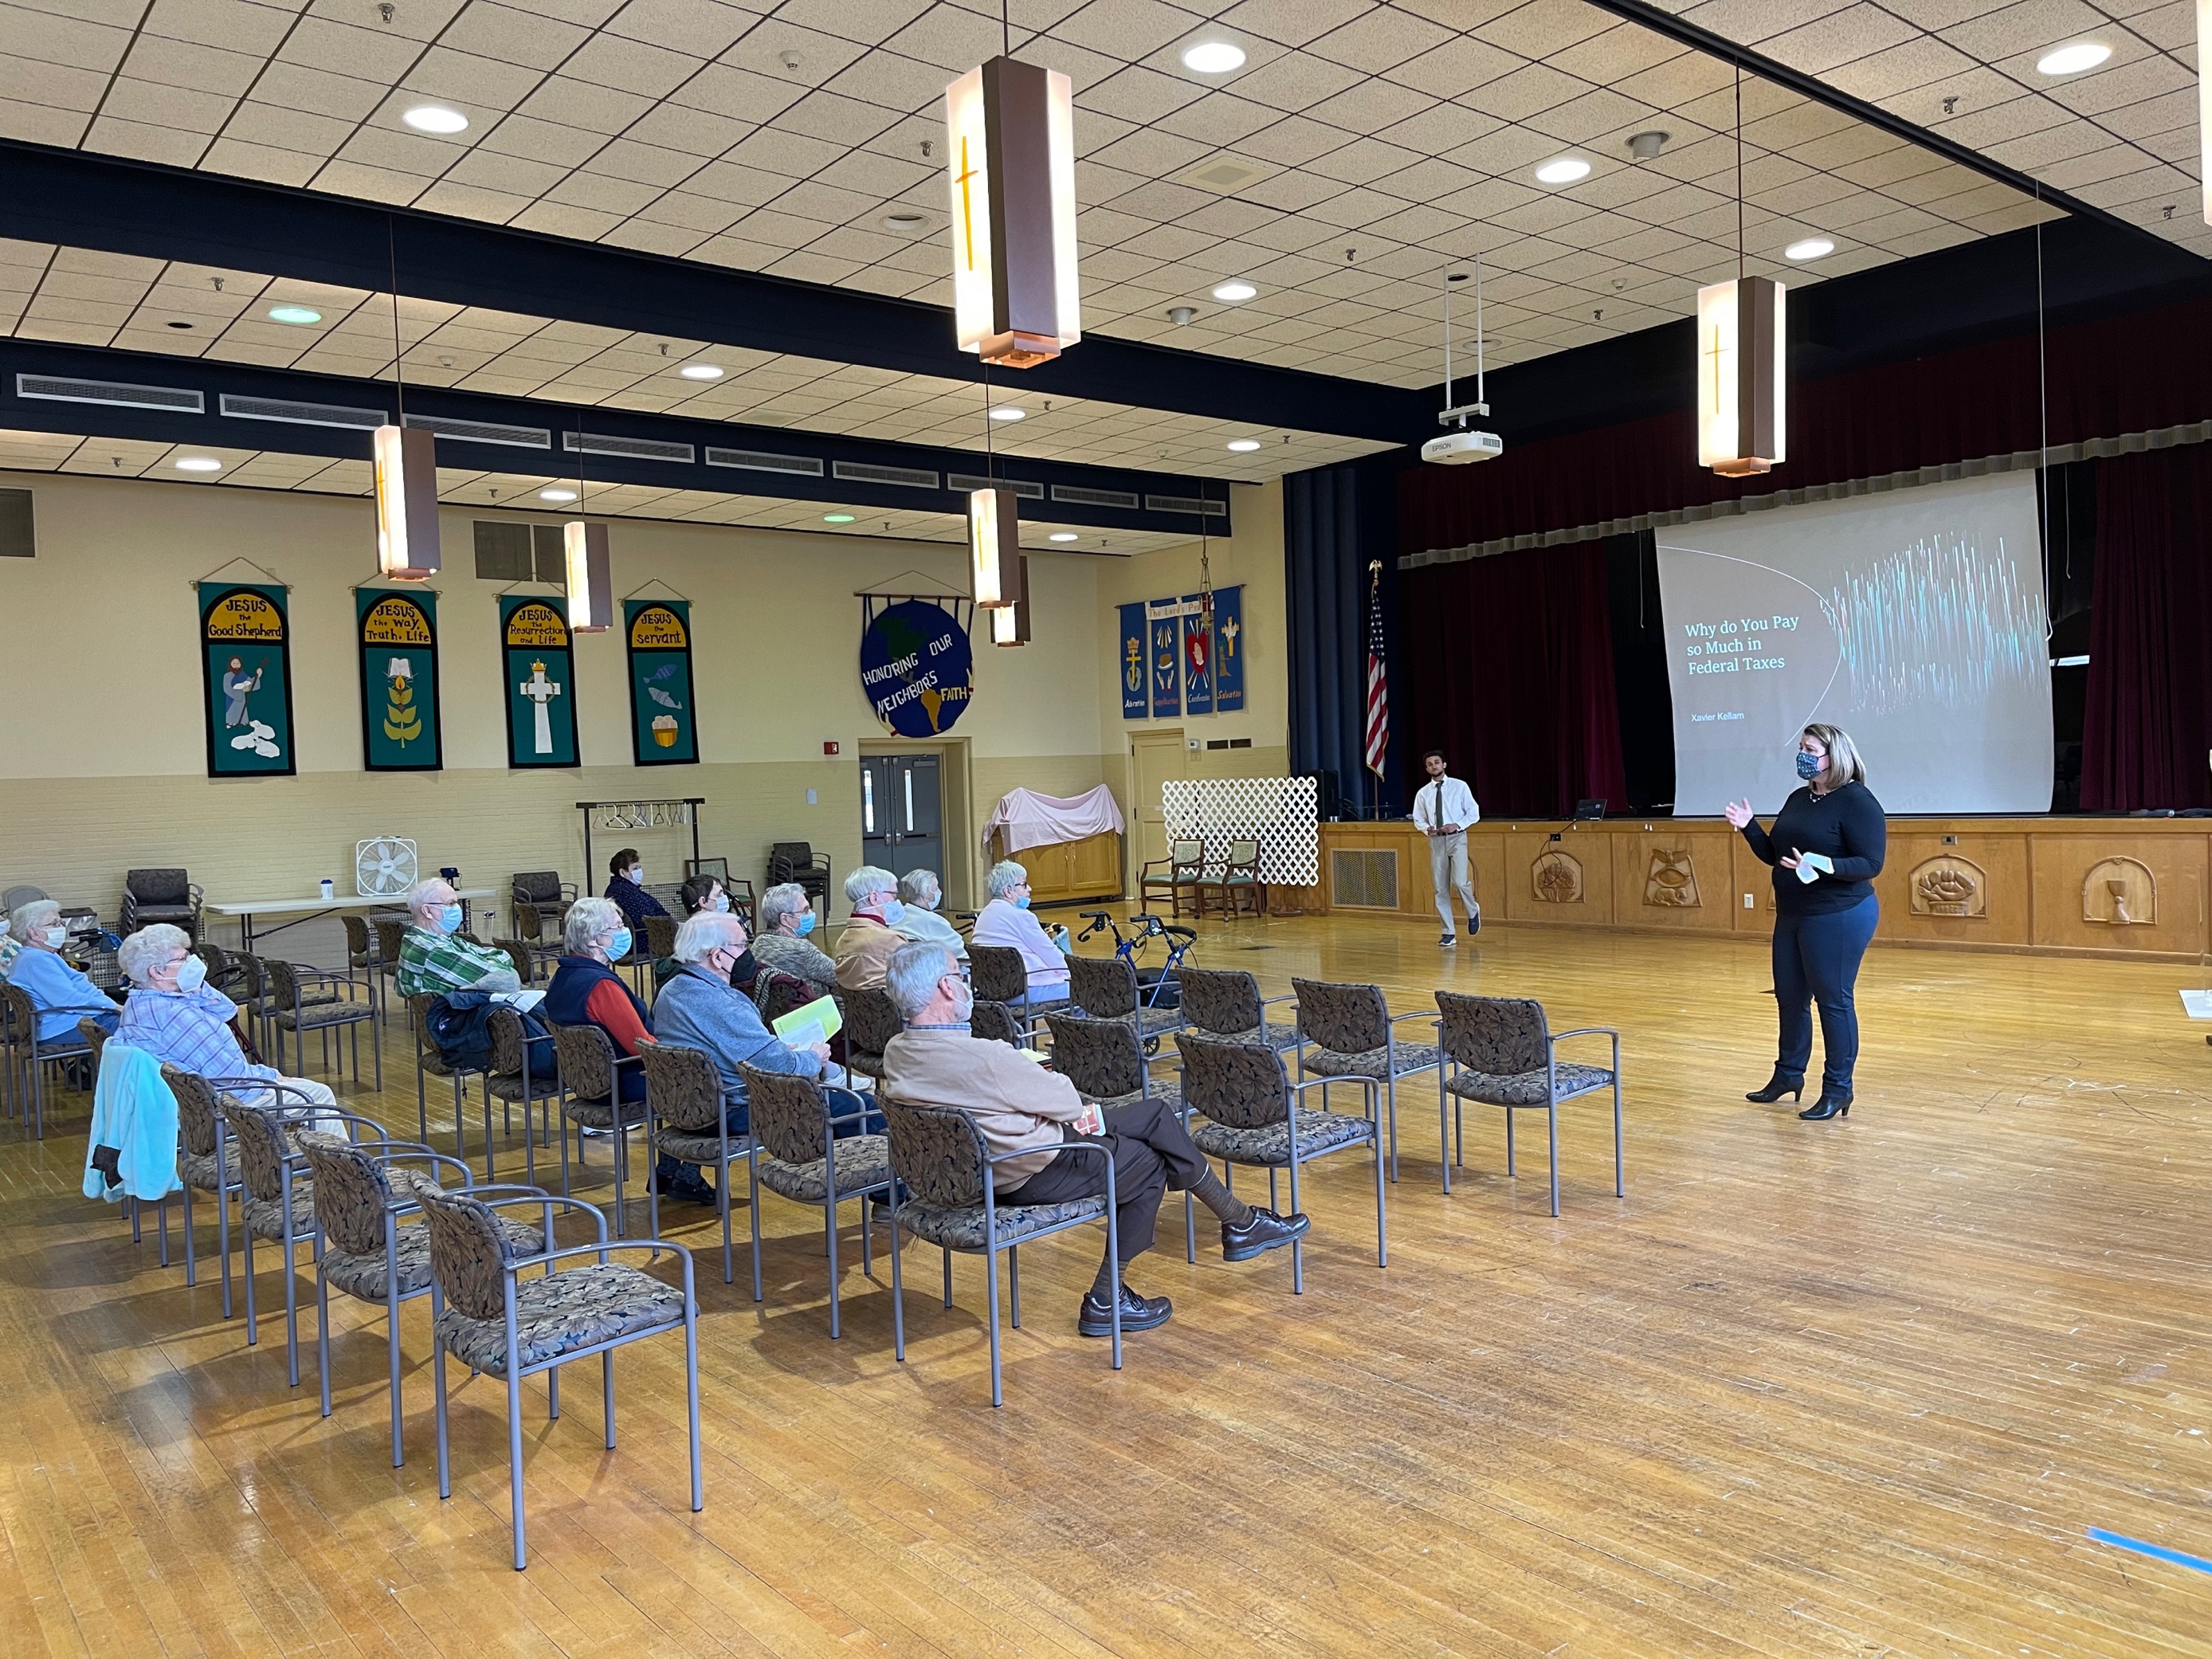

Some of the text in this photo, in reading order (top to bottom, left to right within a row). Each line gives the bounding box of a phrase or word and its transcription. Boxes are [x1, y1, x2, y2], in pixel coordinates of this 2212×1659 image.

[1432, 443, 1452, 452] EPSON
[226, 599, 267, 613] JESUS
[376, 605, 414, 618] JESUS
[1148, 607, 1162, 618] The
[519, 610, 553, 622] JESUS
[641, 614, 672, 625] JESUS
[209, 623, 281, 639] Good Shepherd
[510, 624, 567, 636] Resurrection
[1684, 615, 1799, 639] Why do You Pay
[406, 631, 429, 642] Life
[539, 635, 557, 645] Life
[637, 631, 681, 644] servant
[1686, 637, 1762, 657] so Much in
[862, 633, 952, 686] HONORING OUR
[1688, 657, 1786, 675] Federal Taxes
[940, 686, 968, 702] FAITH
[1717, 712, 1745, 721] Kellam
